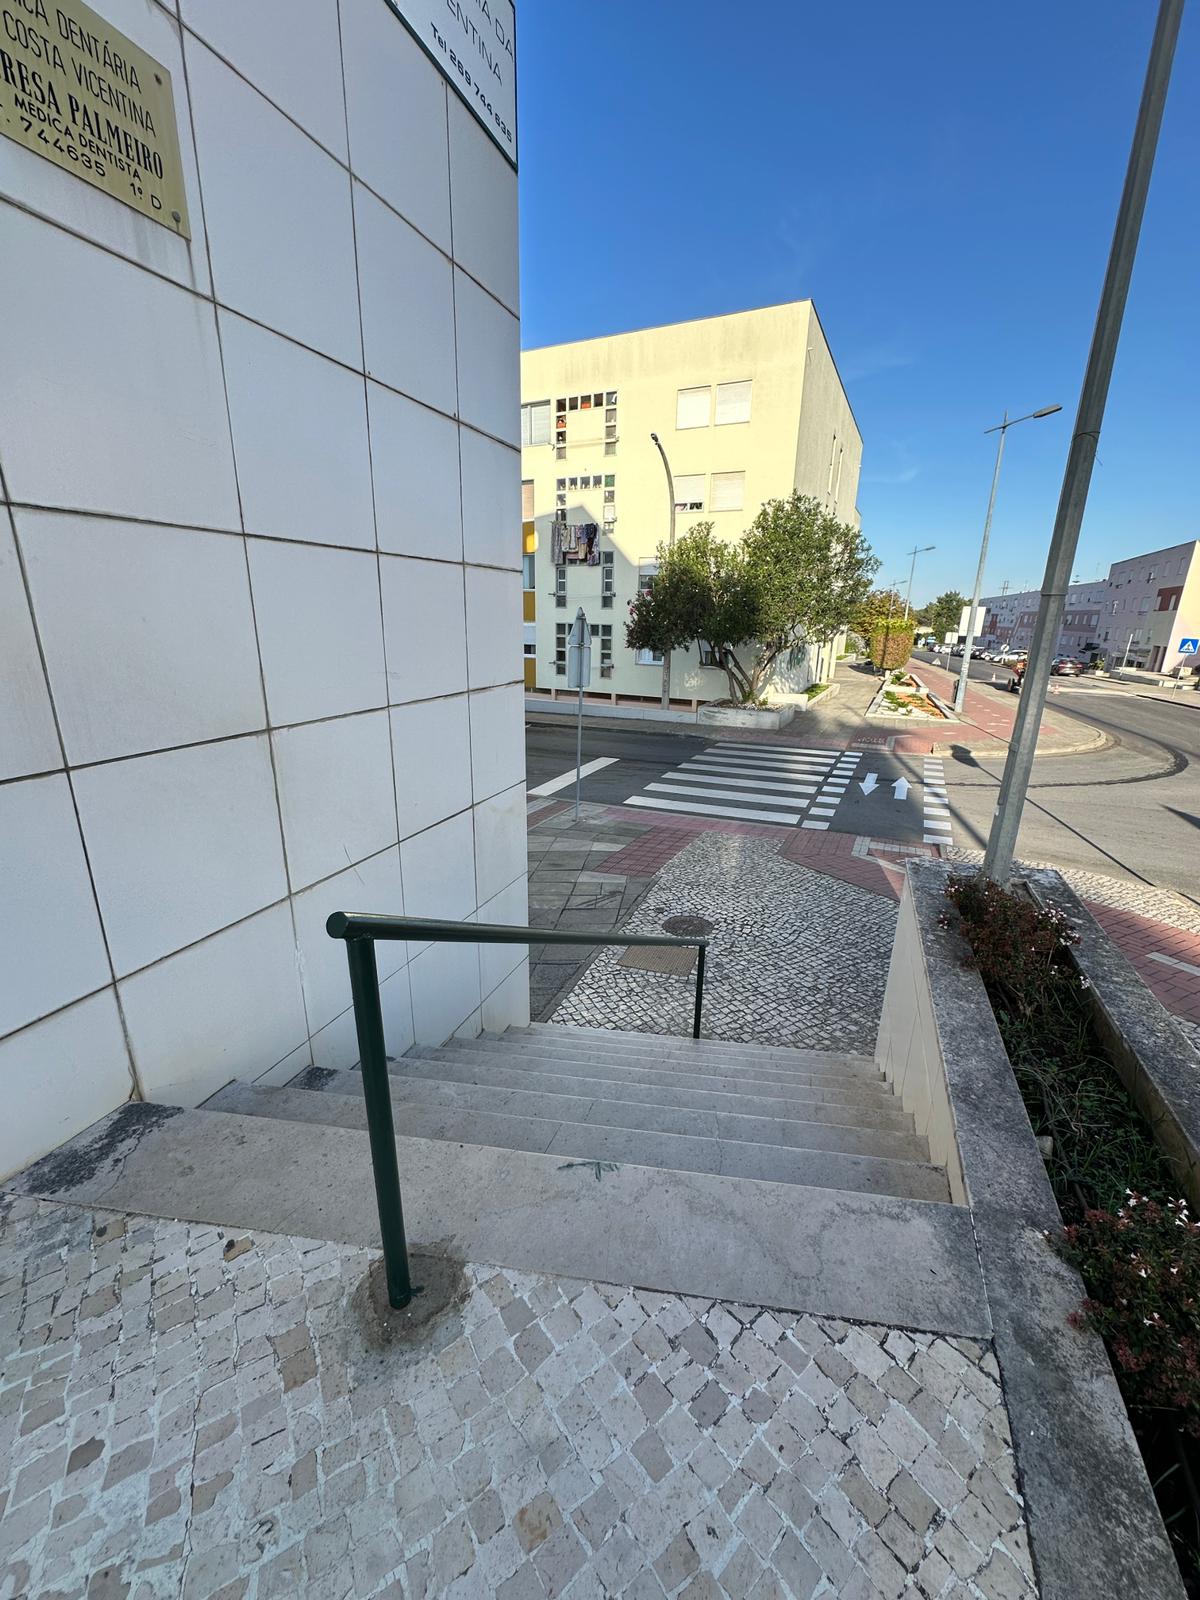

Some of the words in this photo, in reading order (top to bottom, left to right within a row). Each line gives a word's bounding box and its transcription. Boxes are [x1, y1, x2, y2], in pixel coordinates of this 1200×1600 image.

[3, 10, 67, 76] COSTA
[56, 9, 141, 94] DENTÁRIA
[495, 18, 514, 62] DA
[0, 49, 62, 116] RESA
[67, 92, 164, 180] PALMEIRO
[71, 57, 156, 138] VICENTINA
[431, 22, 447, 53] Tel
[450, 49, 472, 87] 269
[474, 82, 493, 116] 744
[495, 113, 512, 143] 635
[20, 115, 106, 177] 744635
[150, 194, 162, 210] D
[79, 133, 142, 182] DENTISTA
